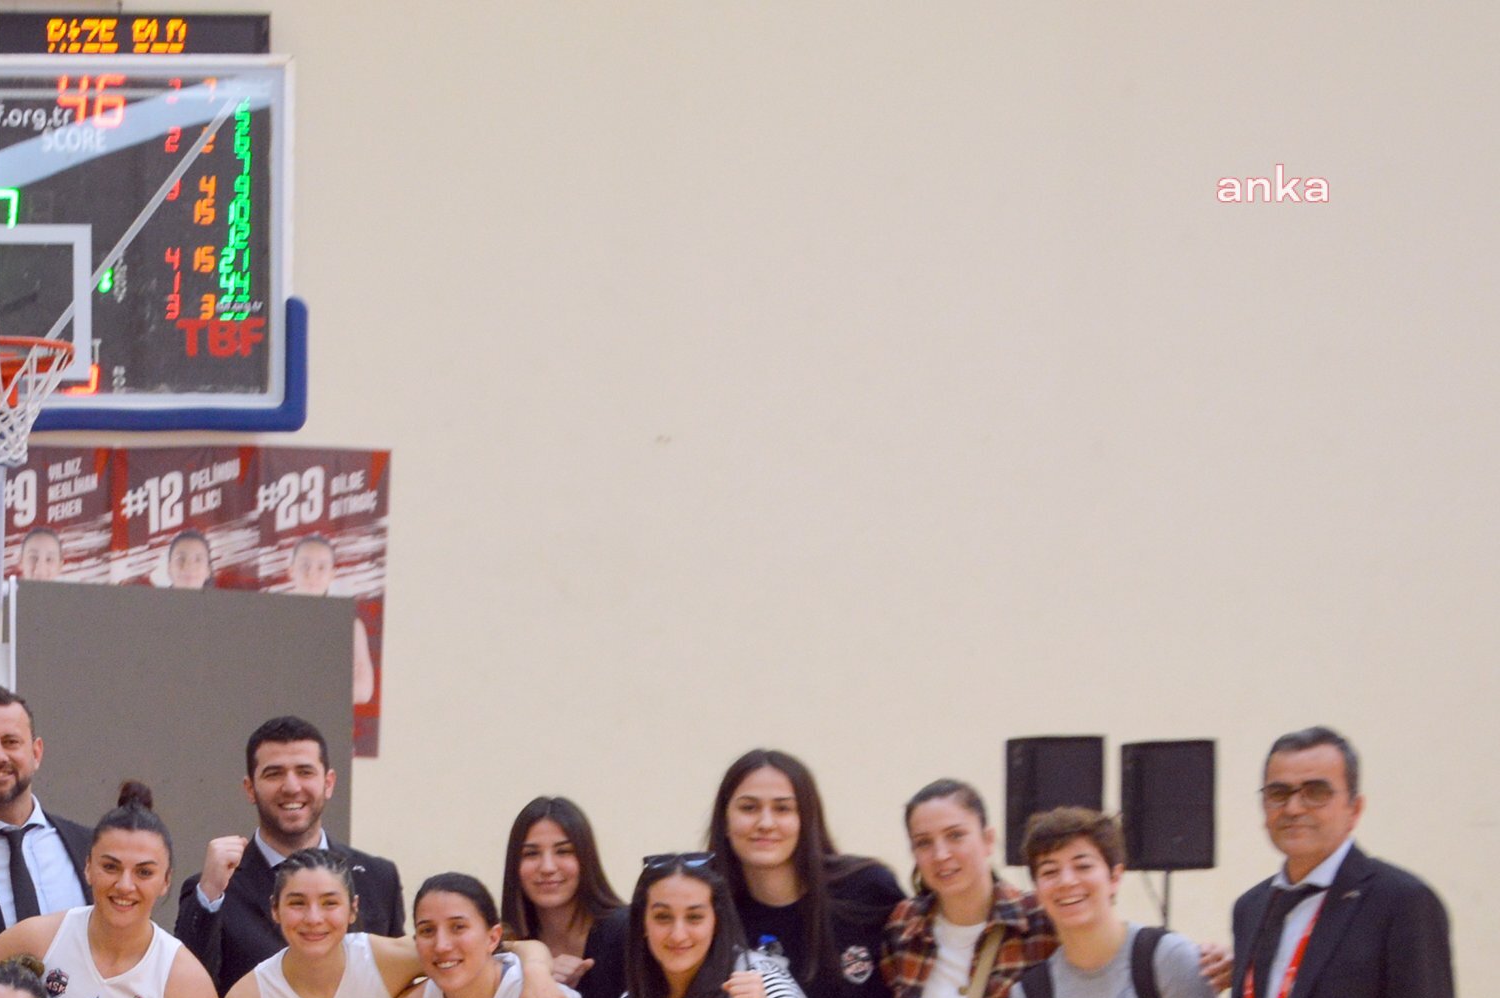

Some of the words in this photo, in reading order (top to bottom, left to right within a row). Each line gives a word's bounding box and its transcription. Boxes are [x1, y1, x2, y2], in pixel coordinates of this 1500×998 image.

[57, 73, 127, 129] 46
[42, 125, 107, 151] SCORE
[176, 318, 266, 357] TBF
[120, 470, 183, 535] #12
[257, 465, 325, 532] #23
